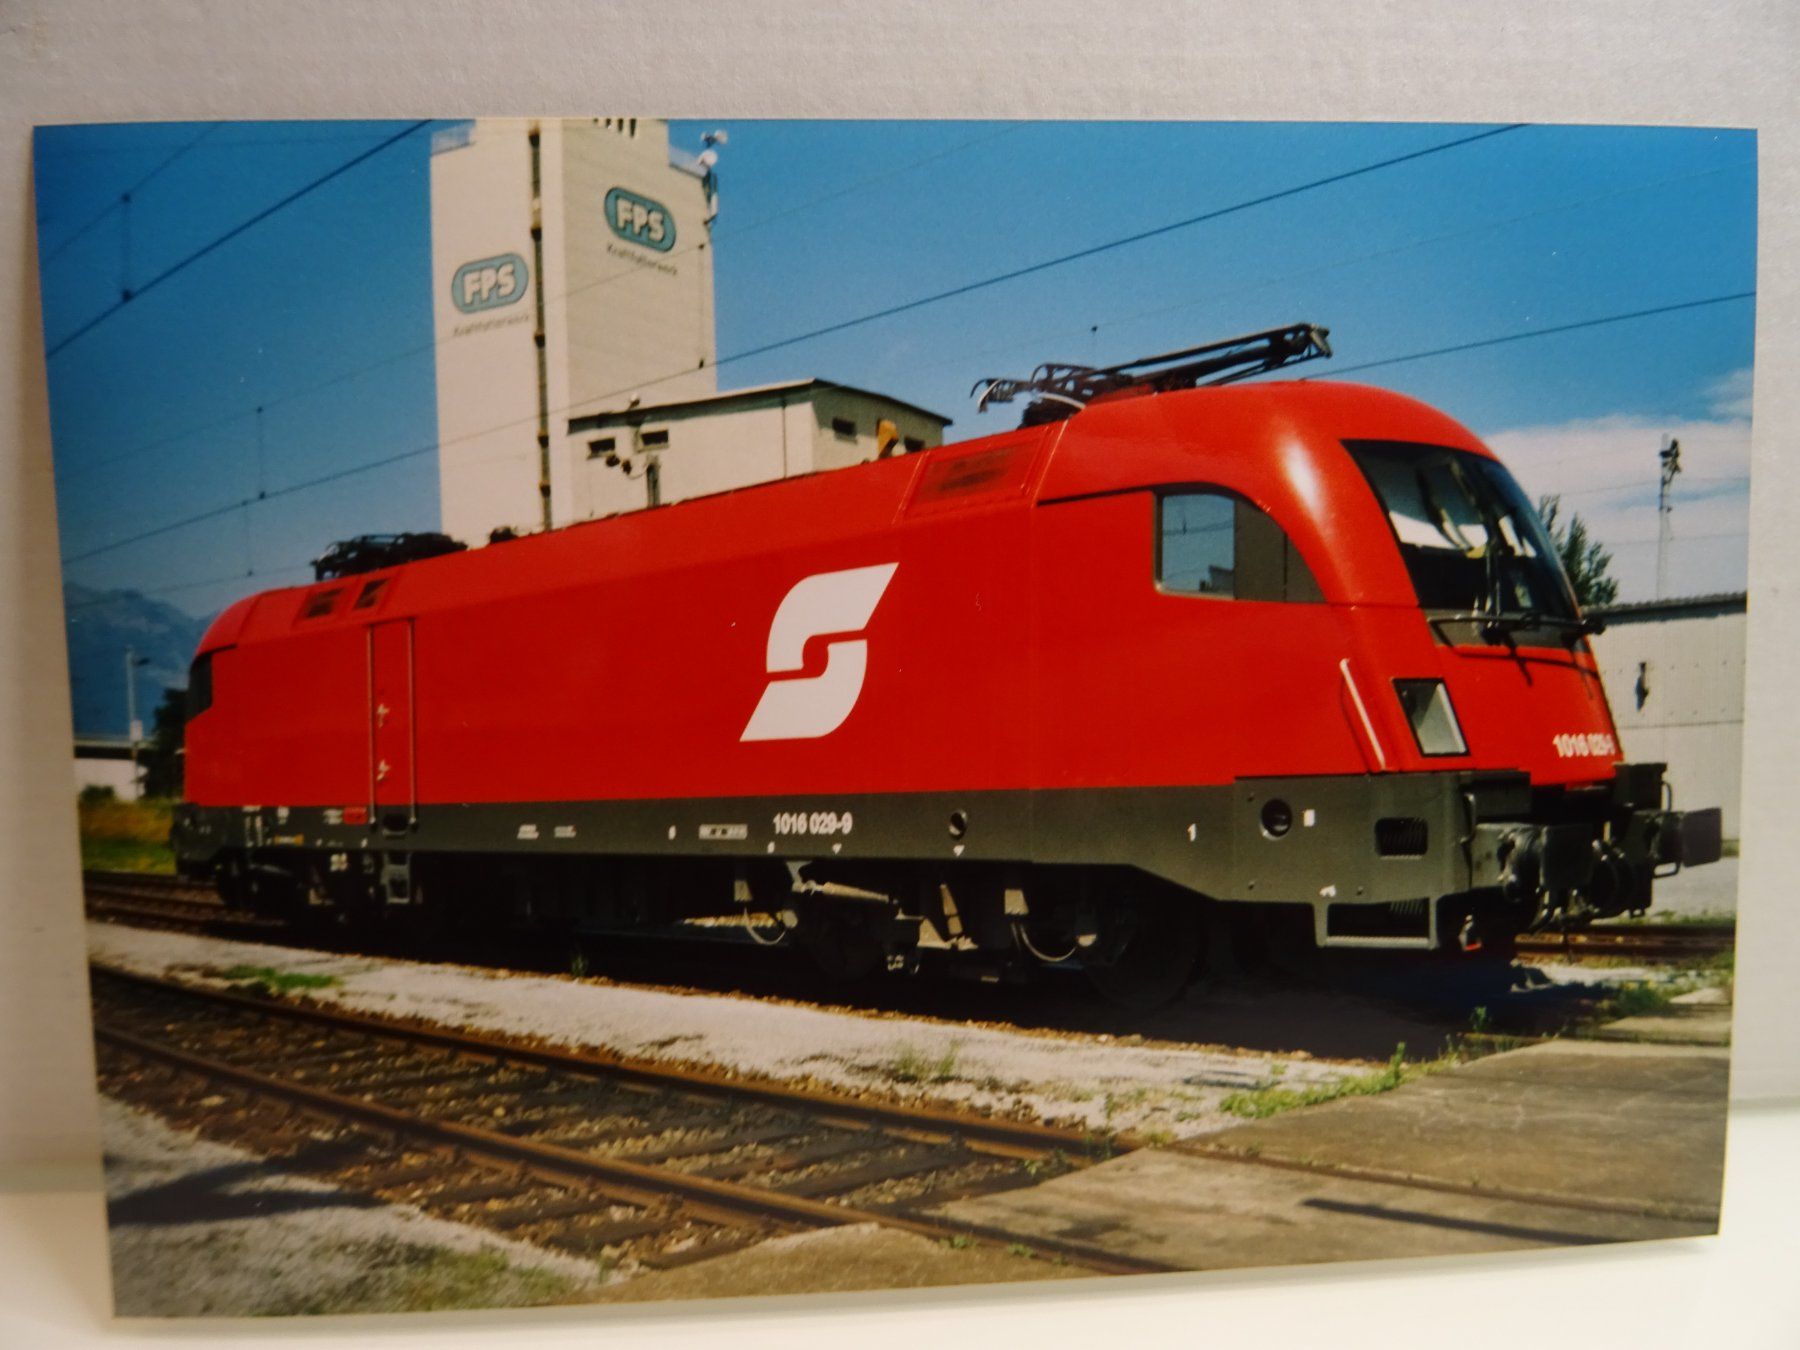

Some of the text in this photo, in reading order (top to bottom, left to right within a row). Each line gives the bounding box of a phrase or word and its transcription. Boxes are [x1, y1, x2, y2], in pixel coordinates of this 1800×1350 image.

[616, 199, 665, 242] FPS
[463, 262, 516, 305] FPS
[773, 812, 808, 835] 1016
[809, 811, 853, 835] 029-9
